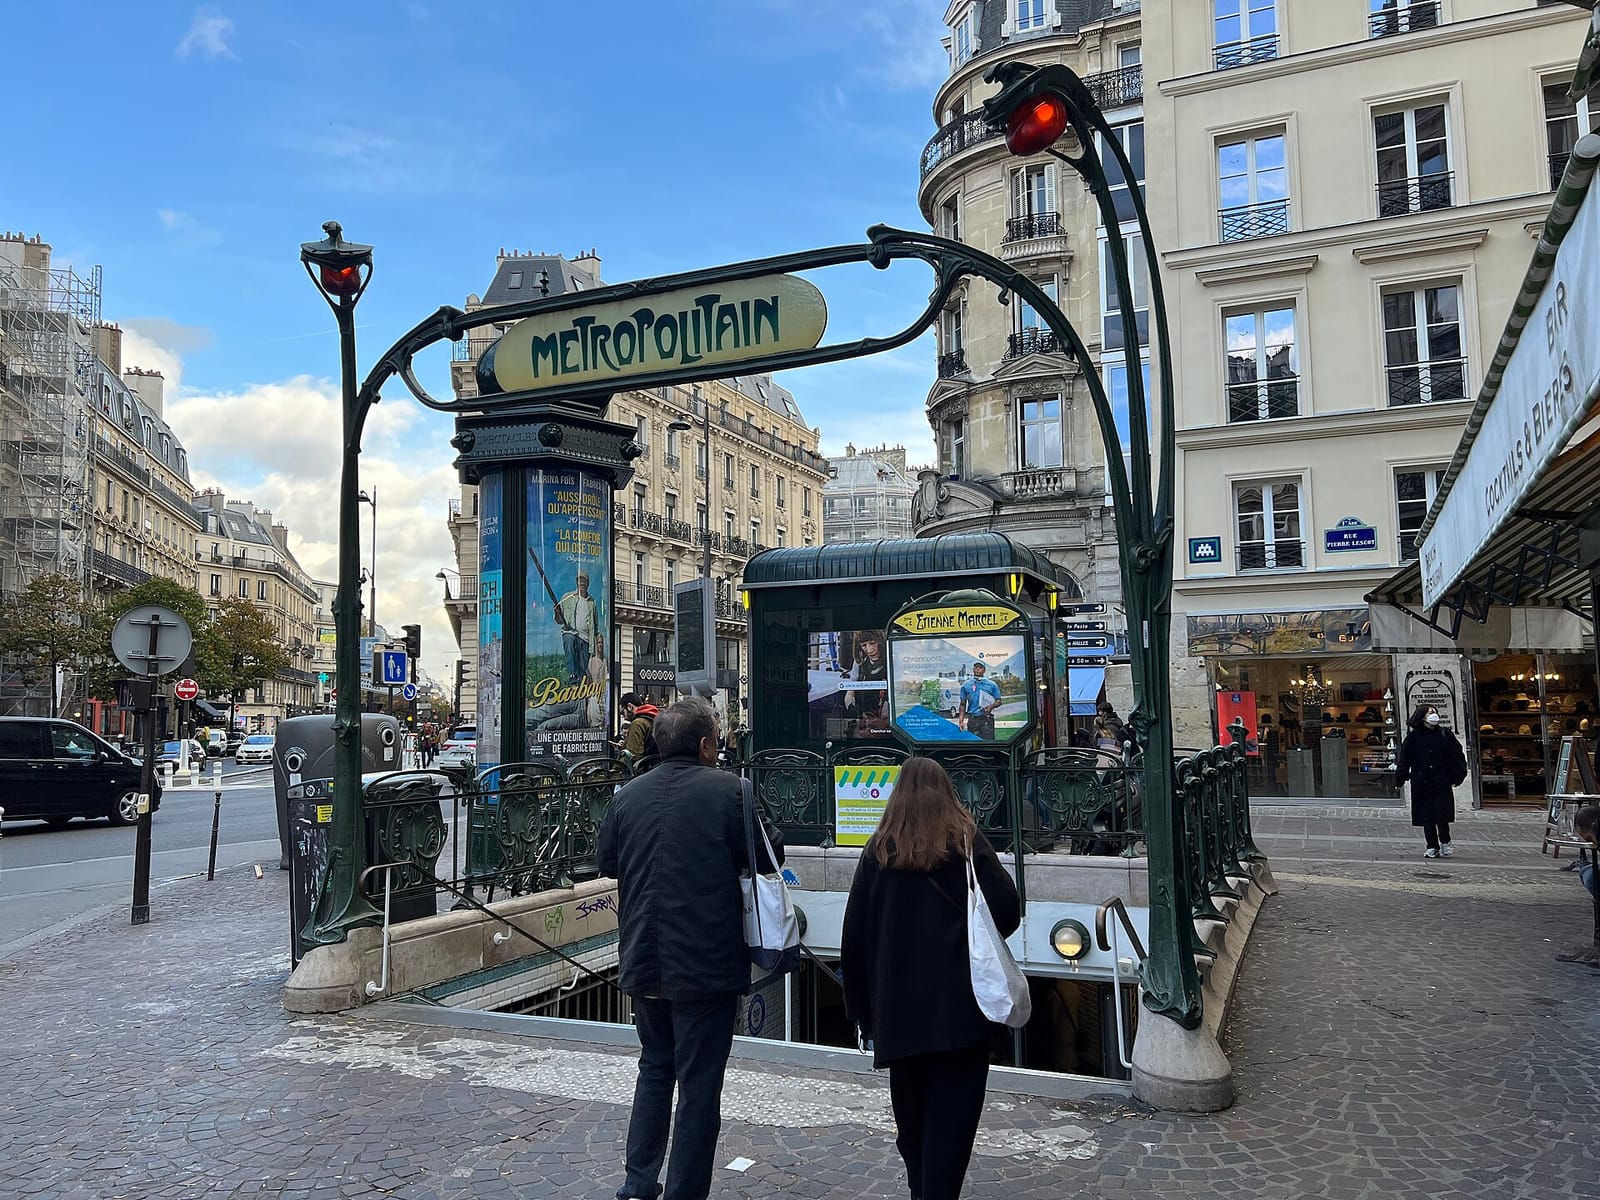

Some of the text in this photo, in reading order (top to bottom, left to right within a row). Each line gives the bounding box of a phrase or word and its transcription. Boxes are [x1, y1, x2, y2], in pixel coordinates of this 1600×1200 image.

[531, 294, 780, 379] METROPOLITAIN
[531, 474, 560, 485] MARINA
[555, 541, 570, 553] QUI
[571, 542, 586, 554] OSE
[1351, 539, 1376, 547] LESCOT
[958, 610, 998, 629] MARCEL
[537, 733, 552, 742] UNE
[553, 731, 583, 742] COMÉDIE
[552, 744, 562, 754] DE
[562, 743, 588, 753] FABRICE
